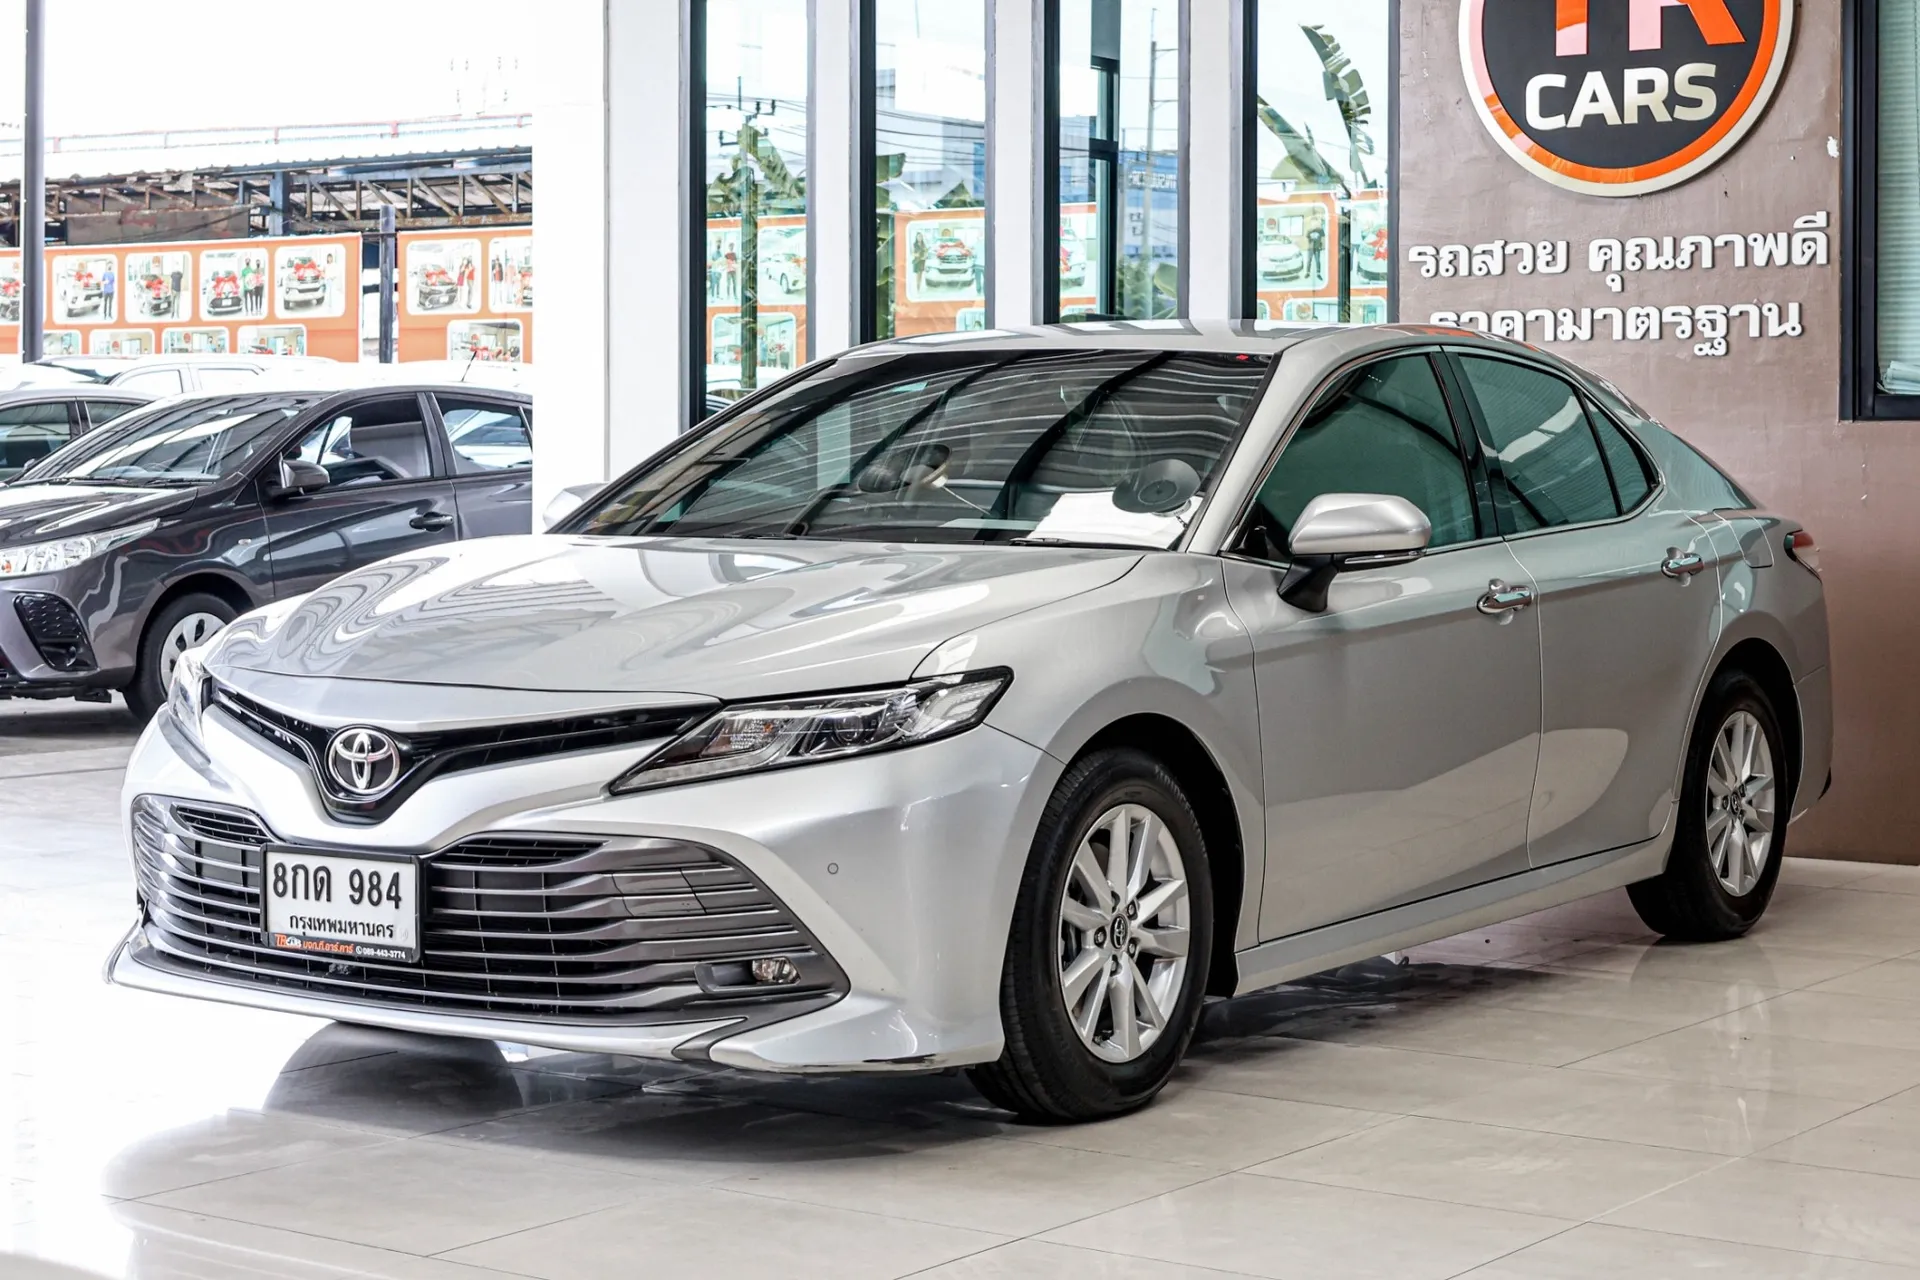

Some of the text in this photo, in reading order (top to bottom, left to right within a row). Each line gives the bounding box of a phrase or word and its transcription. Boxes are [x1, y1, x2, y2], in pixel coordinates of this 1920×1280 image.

[1526, 63, 1717, 131] CARS
[1408, 211, 1829, 292] รถสวย คุณภาพดี
[273, 862, 402, 909] 8กด 984
[290, 914, 394, 938] กรุงเทพมหานคร
